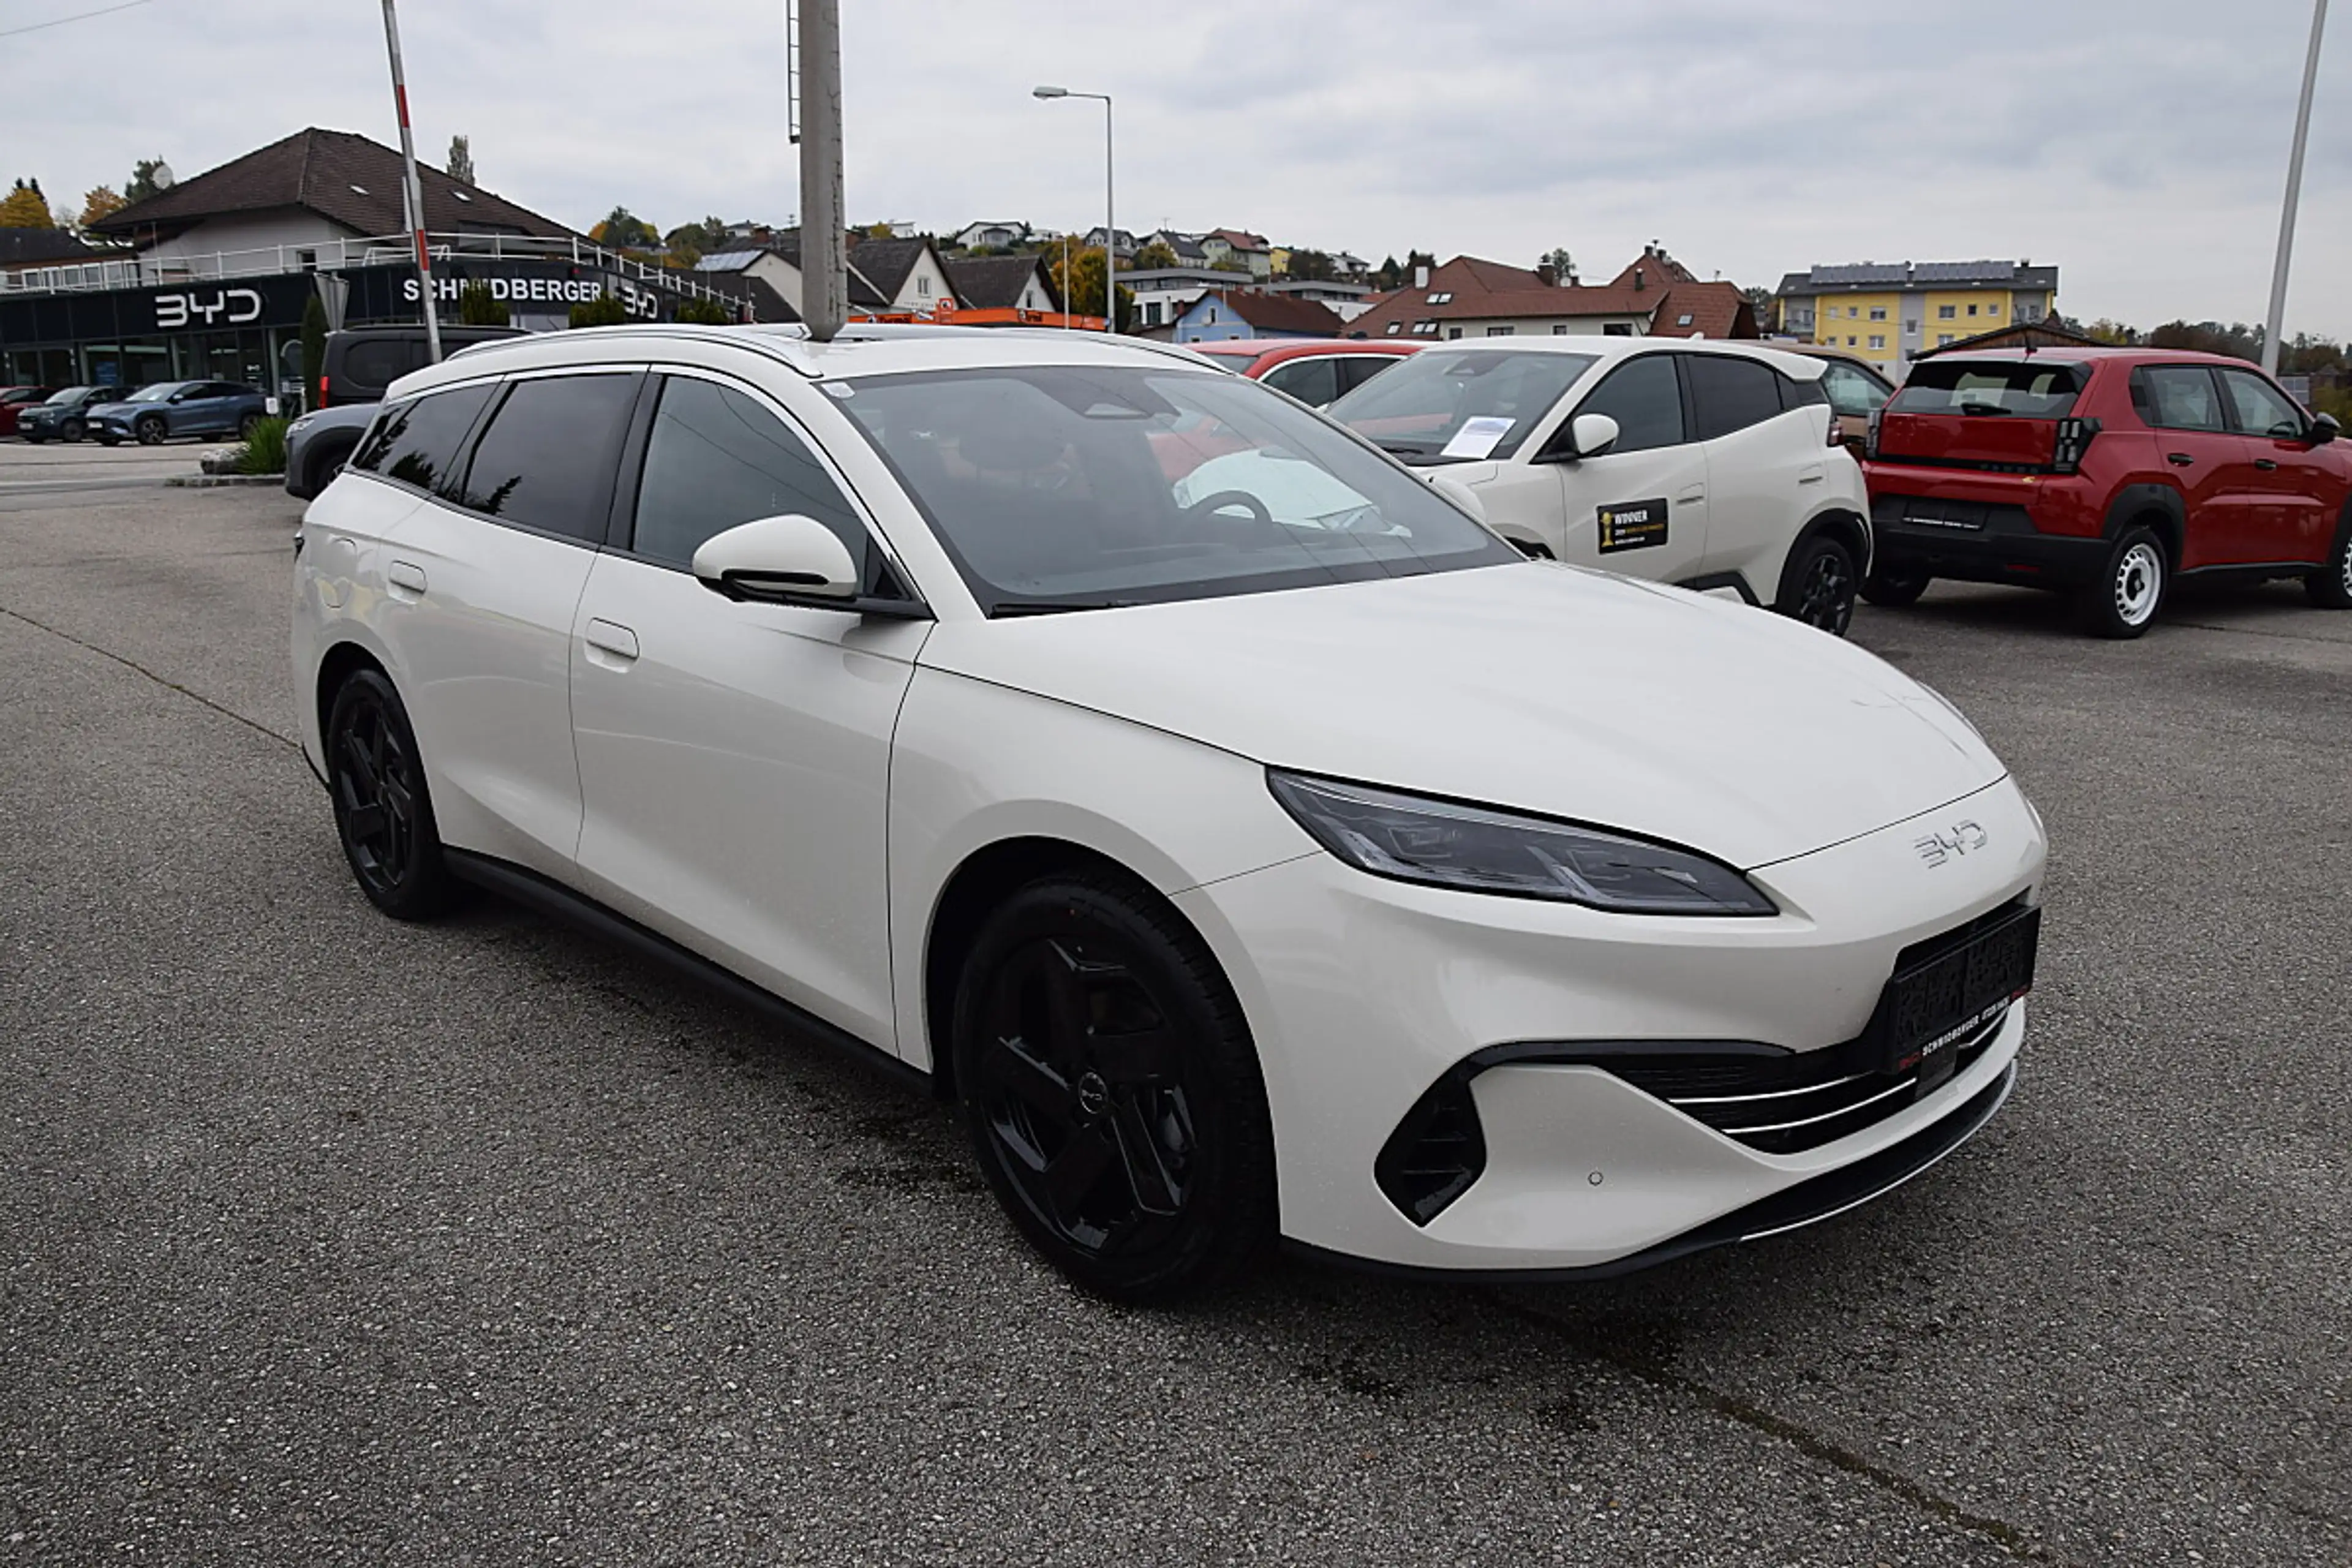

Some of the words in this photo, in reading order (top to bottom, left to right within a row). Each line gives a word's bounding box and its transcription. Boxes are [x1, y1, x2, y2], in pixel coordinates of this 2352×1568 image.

[155, 288, 261, 327] BYD
[622, 286, 658, 318] BYD
[1912, 820, 1988, 869] BYD
